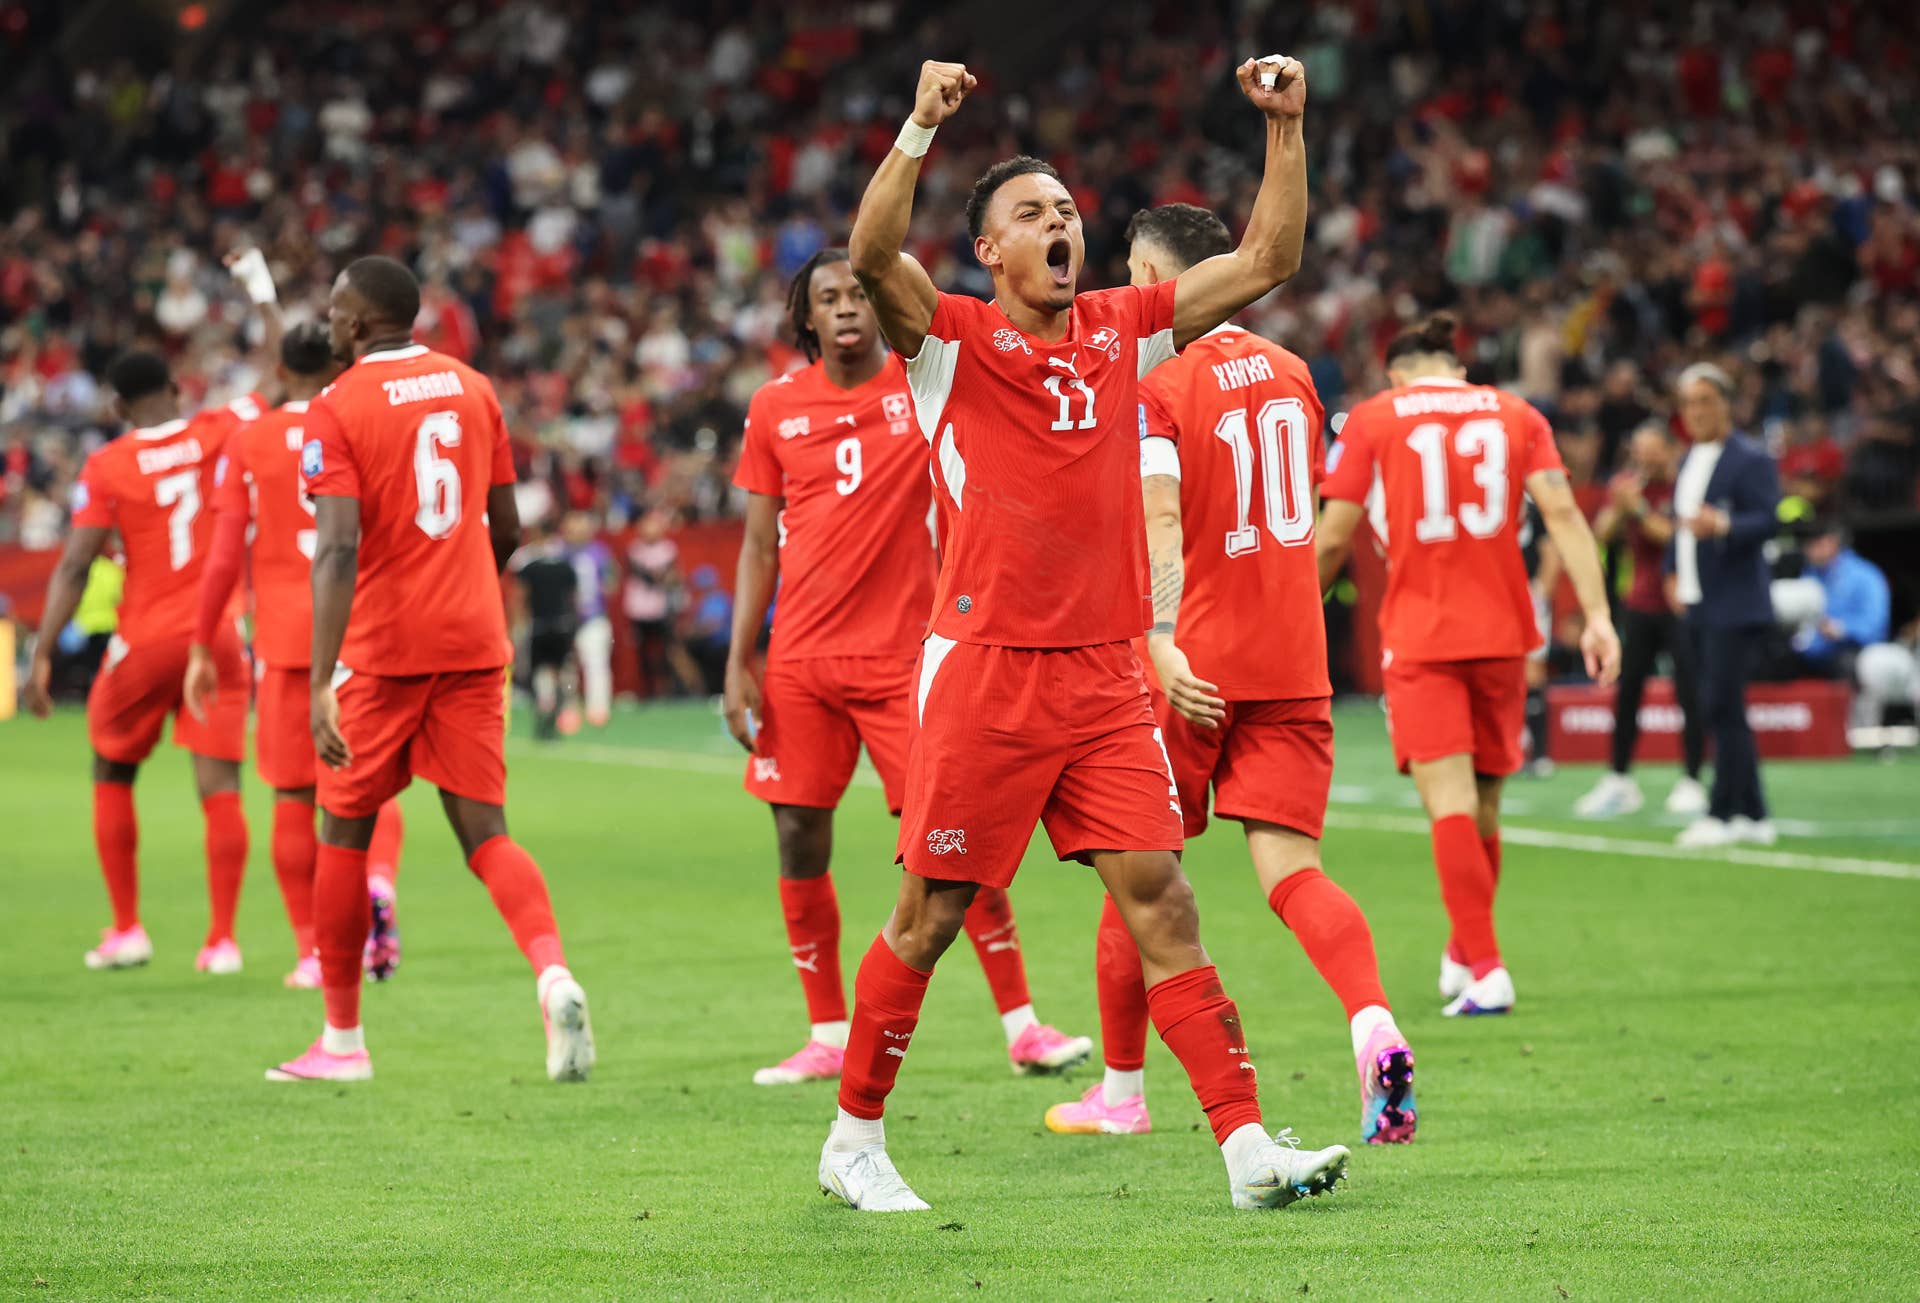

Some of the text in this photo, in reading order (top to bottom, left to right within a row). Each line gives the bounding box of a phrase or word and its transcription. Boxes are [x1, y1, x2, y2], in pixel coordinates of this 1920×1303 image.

[382, 371, 464, 406] ZAKARIA
[1042, 375, 1098, 431] 11
[1212, 354, 1275, 391] XHAKA
[413, 410, 462, 540] 6
[836, 437, 863, 497] 9
[1214, 397, 1315, 559] 10
[1406, 418, 1510, 544] 13
[154, 469, 203, 572] 7
